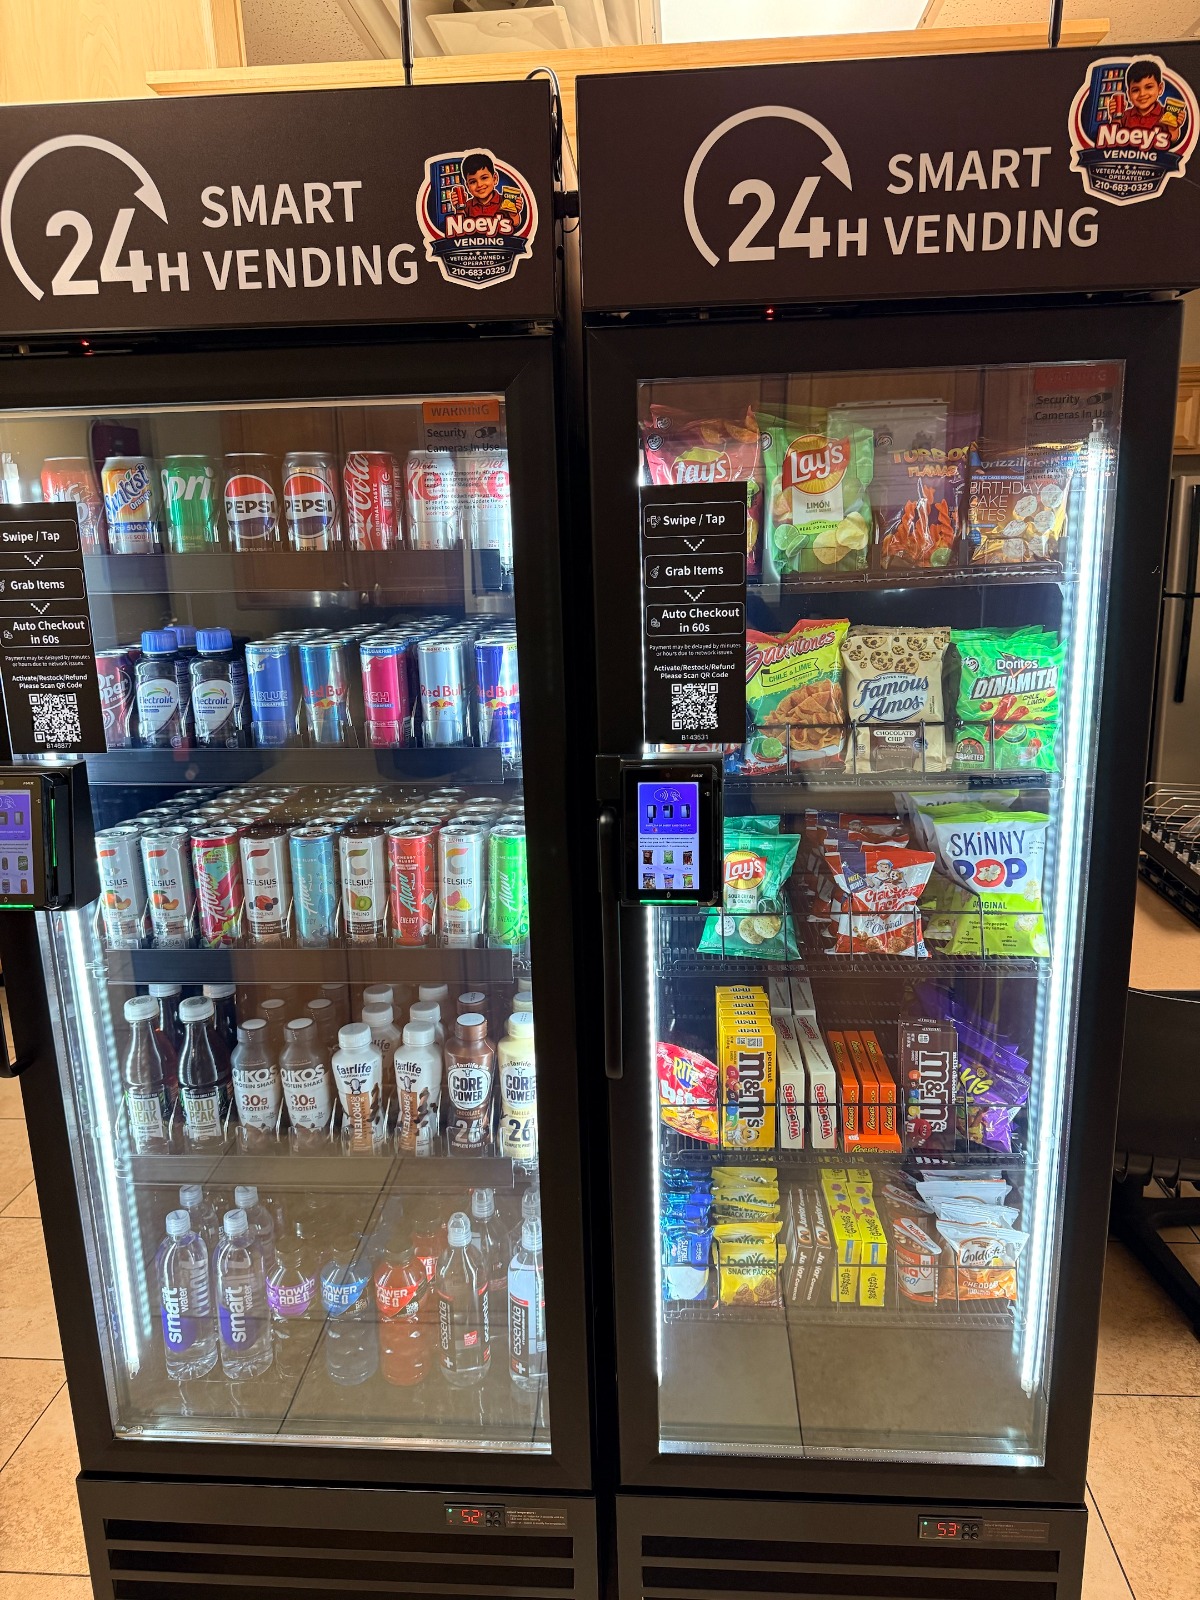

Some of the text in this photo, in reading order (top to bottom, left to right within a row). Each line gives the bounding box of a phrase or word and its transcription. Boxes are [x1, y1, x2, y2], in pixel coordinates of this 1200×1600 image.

[1097, 123, 1169, 151] Noey's
[1103, 150, 1157, 161] VENDING
[886, 146, 1051, 194] SMART
[1095, 180, 1154, 192] 210-683-0329
[201, 180, 362, 228] SMART
[446, 214, 512, 237] Noey's
[884, 206, 1099, 257] VENDING
[454, 237, 504, 247] VENDING
[203, 243, 419, 291] VENDING
[451, 265, 506, 277] 210-683-0329
[1036, 394, 1080, 405] Security
[431, 404, 490, 417] WARNING
[1035, 410, 1080, 420] Cameras
[1083, 410, 1092, 418] In
[427, 428, 467, 439] Security
[427, 443, 499, 453] Cameras In Use
[790, 442, 844, 484] Lay's
[969, 481, 1044, 495] BIRTHDAY
[129, 489, 152, 511] Orange
[285, 499, 333, 513] PEPSI
[806, 500, 831, 509] LIMÓN
[969, 495, 1008, 508] CAKE
[225, 500, 276, 514] PEPSI
[663, 514, 725, 527] Swipe / Tap
[967, 508, 1007, 521] BITES
[2, 531, 60, 543] Swipe / Tap
[665, 566, 724, 577] Grab Items
[10, 580, 65, 590] Grab Items
[661, 608, 740, 619] Auto Checkout
[13, 620, 85, 631] Auto Checkout
[679, 623, 710, 632] in 60s
[30, 635, 60, 644] in 60s
[654, 663, 735, 672] Activate/Restock/Refund
[996, 659, 1038, 671] Doritos
[12, 674, 88, 682] Activate/Restock/Refund
[769, 661, 812, 683] CHILE LIME
[973, 667, 1058, 699] DINAMITA
[421, 685, 440, 697] Red
[853, 676, 929, 707] Famous
[858, 694, 922, 722] Amos
[725, 858, 763, 882] Lay's
[952, 857, 1028, 888] POP
[246, 878, 278, 887] CELSIUS
[344, 878, 374, 887] CELSIUS
[443, 877, 473, 886] CELSIUS
[864, 884, 918, 904] Cracker
[872, 919, 904, 935] Original
[232, 1064, 278, 1083] OIKOS
[280, 1063, 325, 1083] OIKOS
[336, 1062, 372, 1075] fairlife
[453, 1076, 483, 1091] CORE
[505, 1075, 537, 1091] CORE
[738, 1050, 766, 1129] m&m's
[453, 1090, 483, 1102] POWER
[506, 1089, 536, 1101] POWER
[919, 1051, 949, 1132] m&m's
[187, 1099, 214, 1112] GOLD
[241, 1094, 268, 1106] 30g
[290, 1094, 316, 1106] 30g
[189, 1110, 216, 1123] PEAK
[351, 1100, 363, 1143] PROTEIN
[401, 1098, 411, 1140] PROTEIN
[728, 1267, 752, 1275] SNACK
[278, 1278, 316, 1297] POWER
[179, 1286, 189, 1313] water
[242, 1285, 253, 1311] water
[279, 1294, 300, 1305] ADE
[161, 1286, 183, 1344] smart
[225, 1286, 246, 1343] smart
[438, 1300, 449, 1350] essentia
[511, 1305, 523, 1356] essentia
[461, 1509, 480, 1524] 52
[937, 1522, 957, 1537] 53
